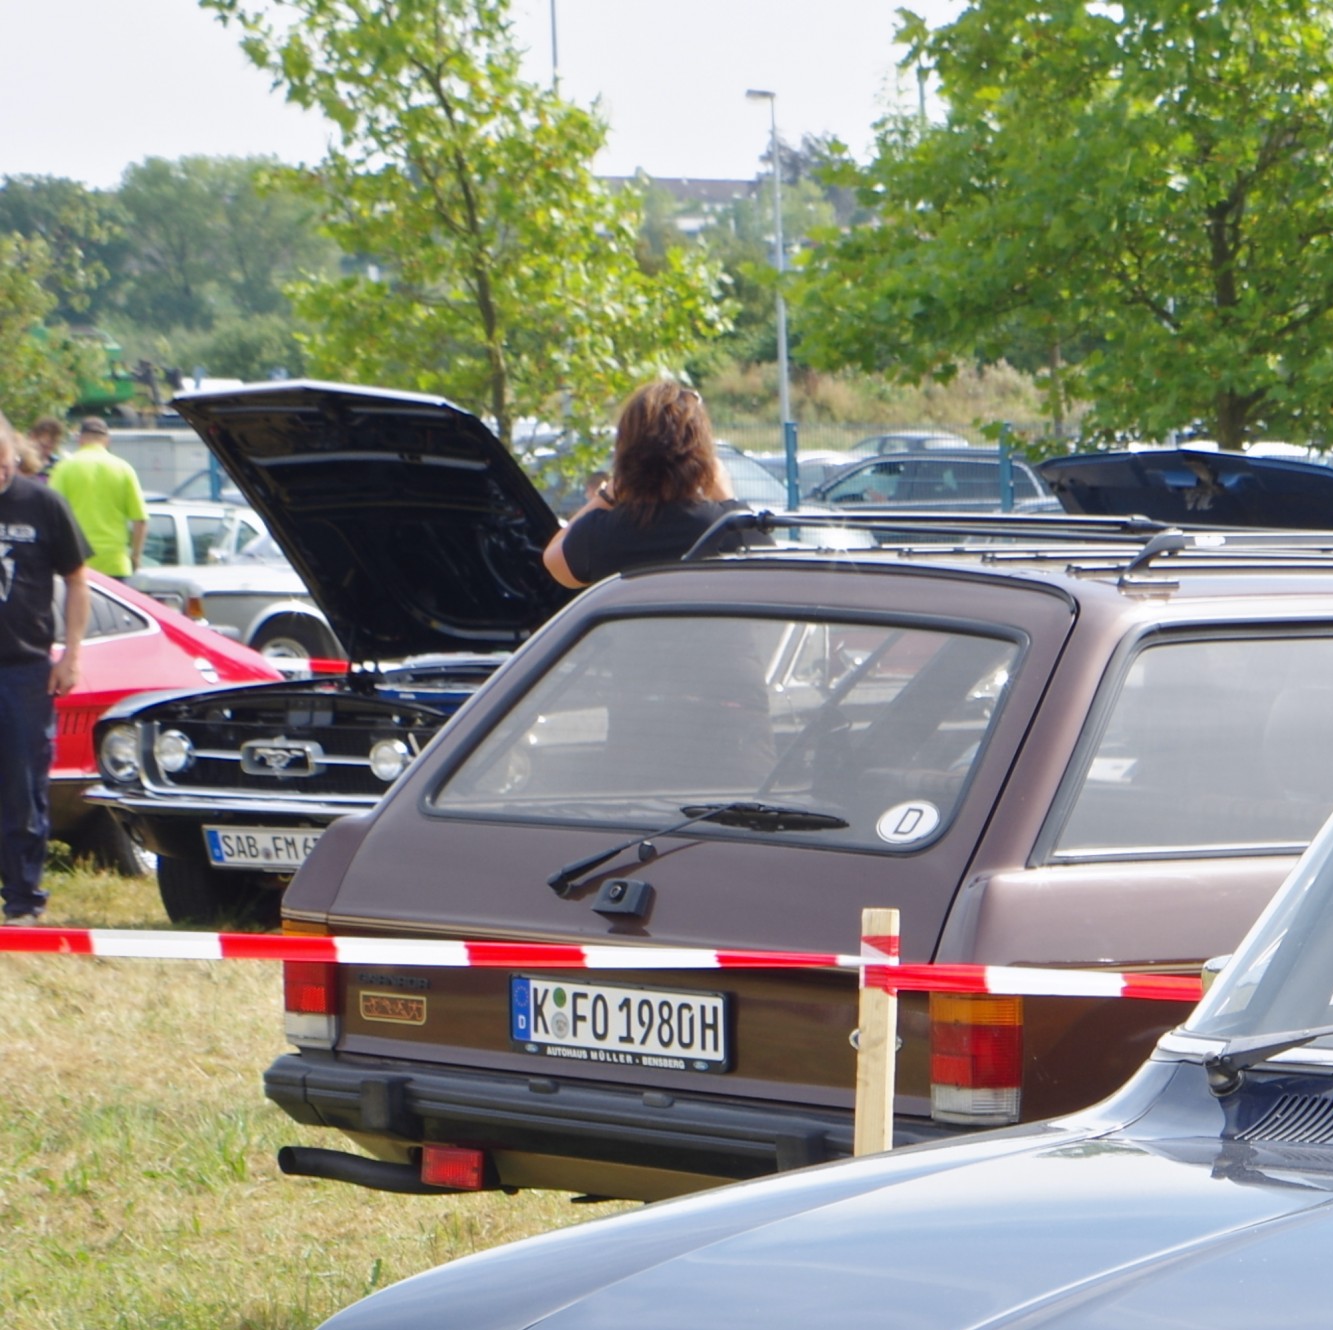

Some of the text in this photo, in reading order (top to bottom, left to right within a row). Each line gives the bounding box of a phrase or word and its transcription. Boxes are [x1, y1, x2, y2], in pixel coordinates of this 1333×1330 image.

[893, 807, 924, 834] D
[222, 835, 260, 858] SAB
[272, 836, 299, 860] FM
[518, 1014, 526, 1029] D
[533, 987, 720, 1052] K FO 1980H
[546, 1046, 686, 1070] AUTOHAUS MÜLLER BENSBERG
